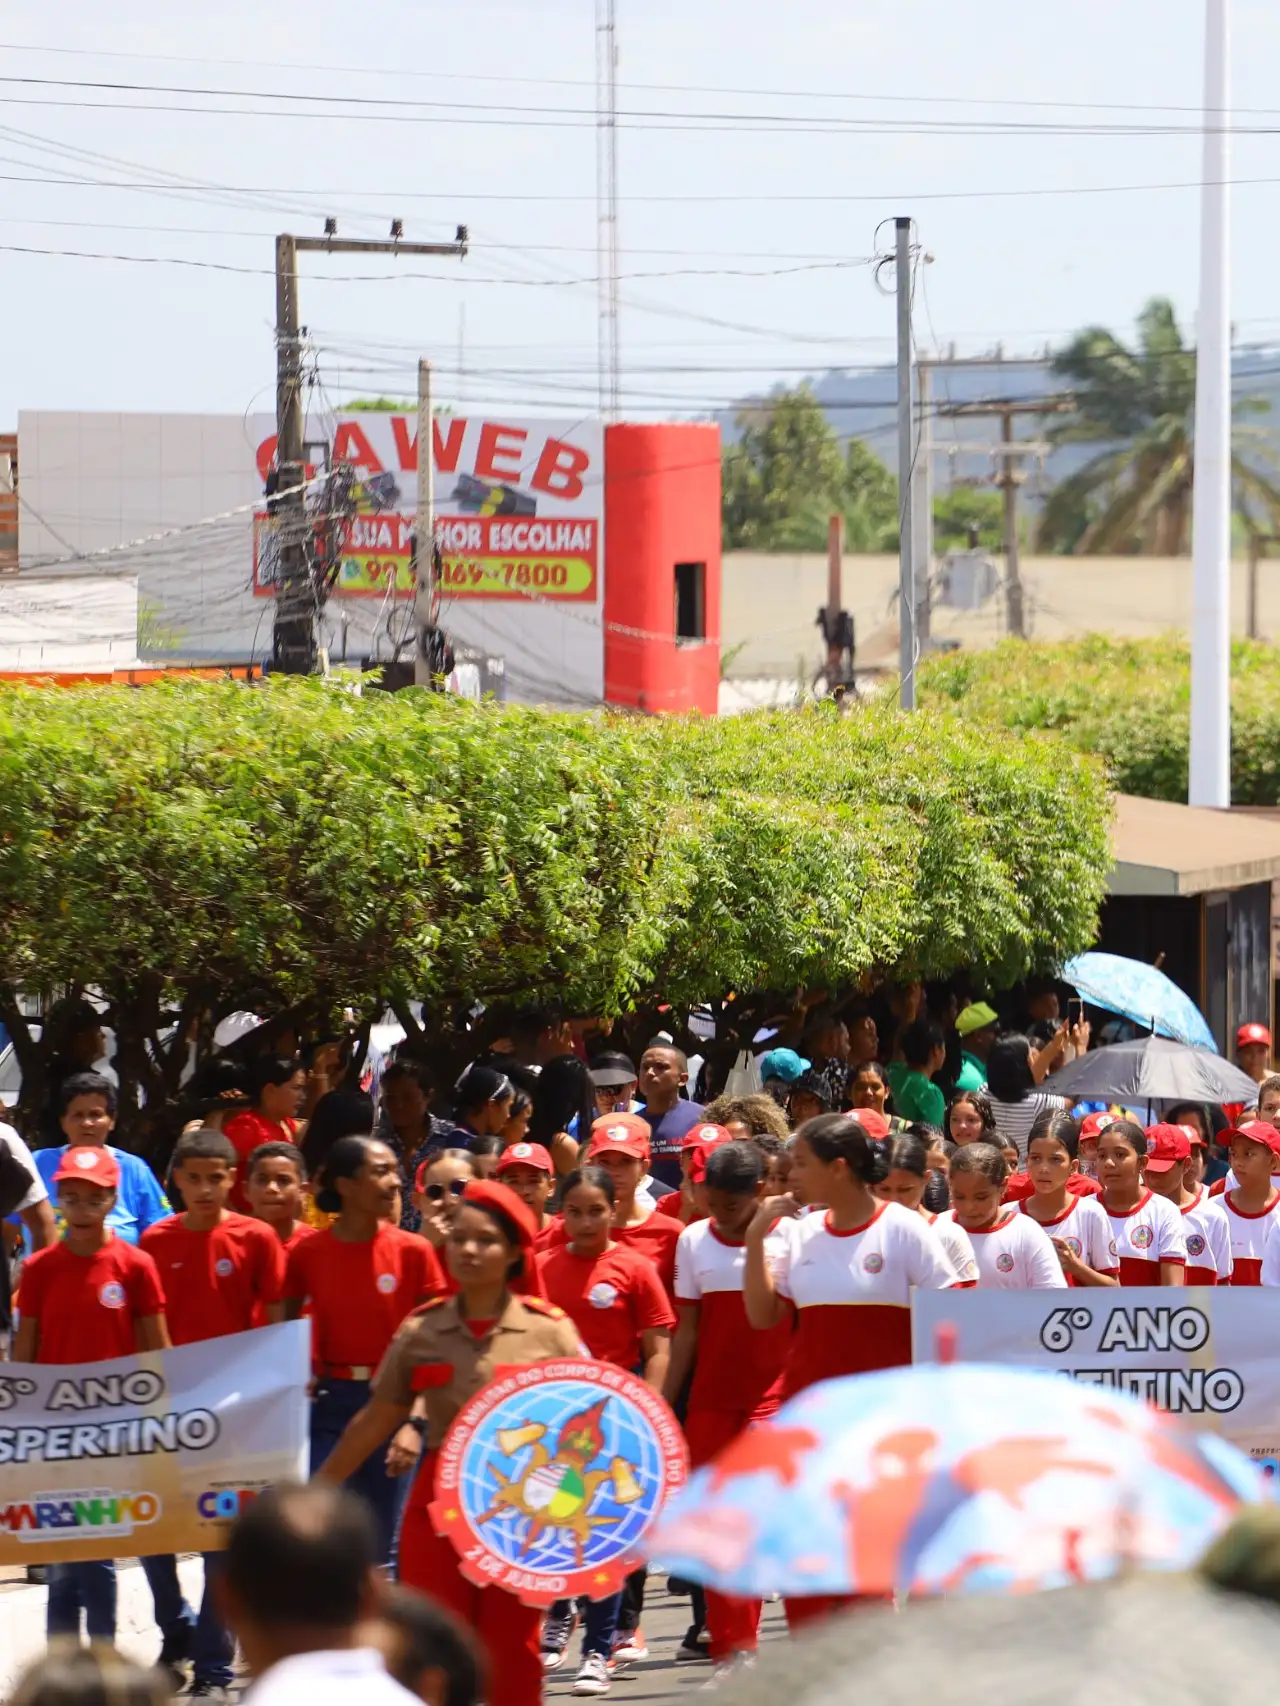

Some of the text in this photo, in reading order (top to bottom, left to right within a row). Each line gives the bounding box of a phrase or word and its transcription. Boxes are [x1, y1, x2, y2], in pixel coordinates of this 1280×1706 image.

[351, 519, 393, 550] SUA
[398, 519, 482, 552] MHOR
[488, 521, 592, 552] ESCOLHA!
[1097, 1306, 1210, 1353] ANO
[45, 1370, 164, 1411] ANO
[198, 1489, 260, 1520] CO
[477, 1553, 508, 1579] DE
